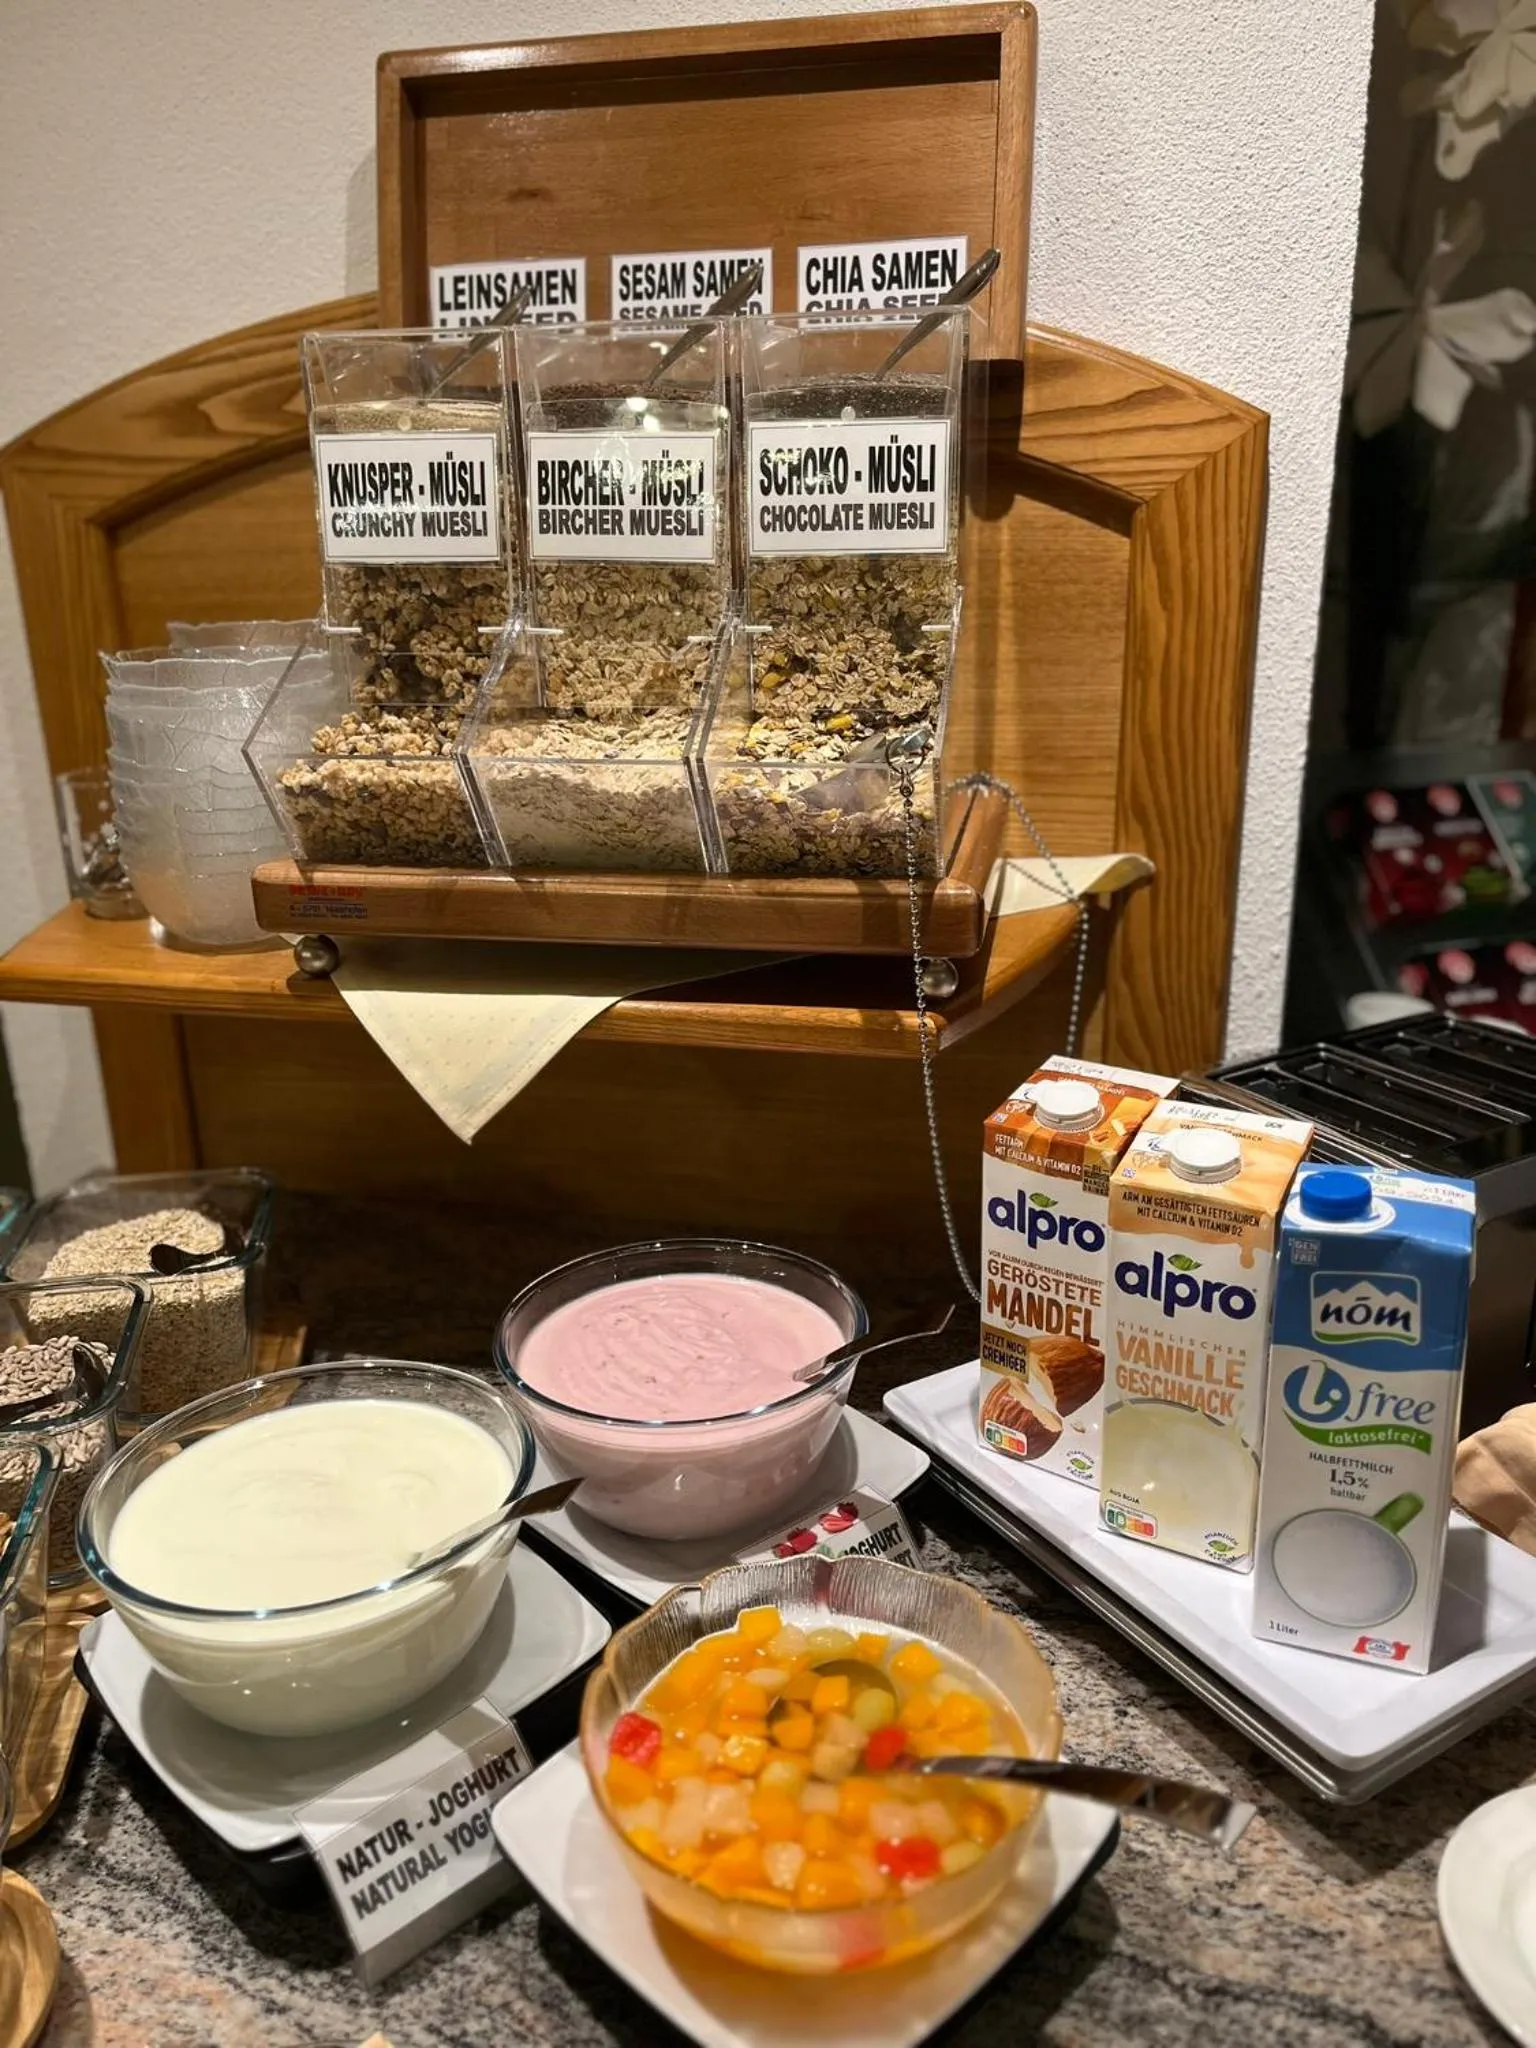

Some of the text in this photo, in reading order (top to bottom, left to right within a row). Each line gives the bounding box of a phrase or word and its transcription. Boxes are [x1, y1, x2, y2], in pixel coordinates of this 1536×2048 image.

[438, 268, 577, 312] LEINSAMEN
[619, 262, 686, 301] SESAM
[805, 248, 958, 295] CHIA SAMEN
[327, 462, 415, 508] KNUSPER
[428, 450, 487, 506] MÜSLI
[537, 459, 625, 506] BIRCHER
[641, 449, 705, 506] MÜSLI
[760, 446, 849, 497] SCHOKO
[868, 434, 936, 494] MÜSLI
[331, 511, 488, 539] CRUNCHY MUESLI
[538, 509, 705, 536] BIRCHER MUESLI
[760, 502, 935, 533] CHOCOLATE MUESLI
[1007, 1148, 1035, 1163] CALCIUM
[1043, 1157, 1071, 1174] VITAMIN
[1122, 1191, 1139, 1202] ARM
[1141, 1194, 1152, 1204] AN
[988, 1189, 1105, 1252] alpro
[1137, 1207, 1243, 1237] MIT CALCIUM & VITAMIN D2
[987, 1258, 1102, 1307] GERÖSTETE
[1115, 1250, 1256, 1320] alpro
[987, 1279, 1100, 1347] MANDEL
[982, 1345, 1027, 1374] CREMIGER
[984, 1332, 1027, 1356] JETZT NOCH
[1116, 1331, 1246, 1390] VANILLE
[1117, 1320, 1246, 1357] HIMMLISCHER
[1115, 1364, 1236, 1417] GESCHMACK
[1344, 1381, 1436, 1425] free
[1309, 1452, 1394, 1475] HALBFETTMILCH
[844, 1521, 903, 1557] GHURT
[1276, 1621, 1300, 1636] Liter
[335, 1818, 415, 1885] NATUR
[428, 1747, 523, 1827] JOGHURT
[350, 1843, 448, 1920] NATURAL
